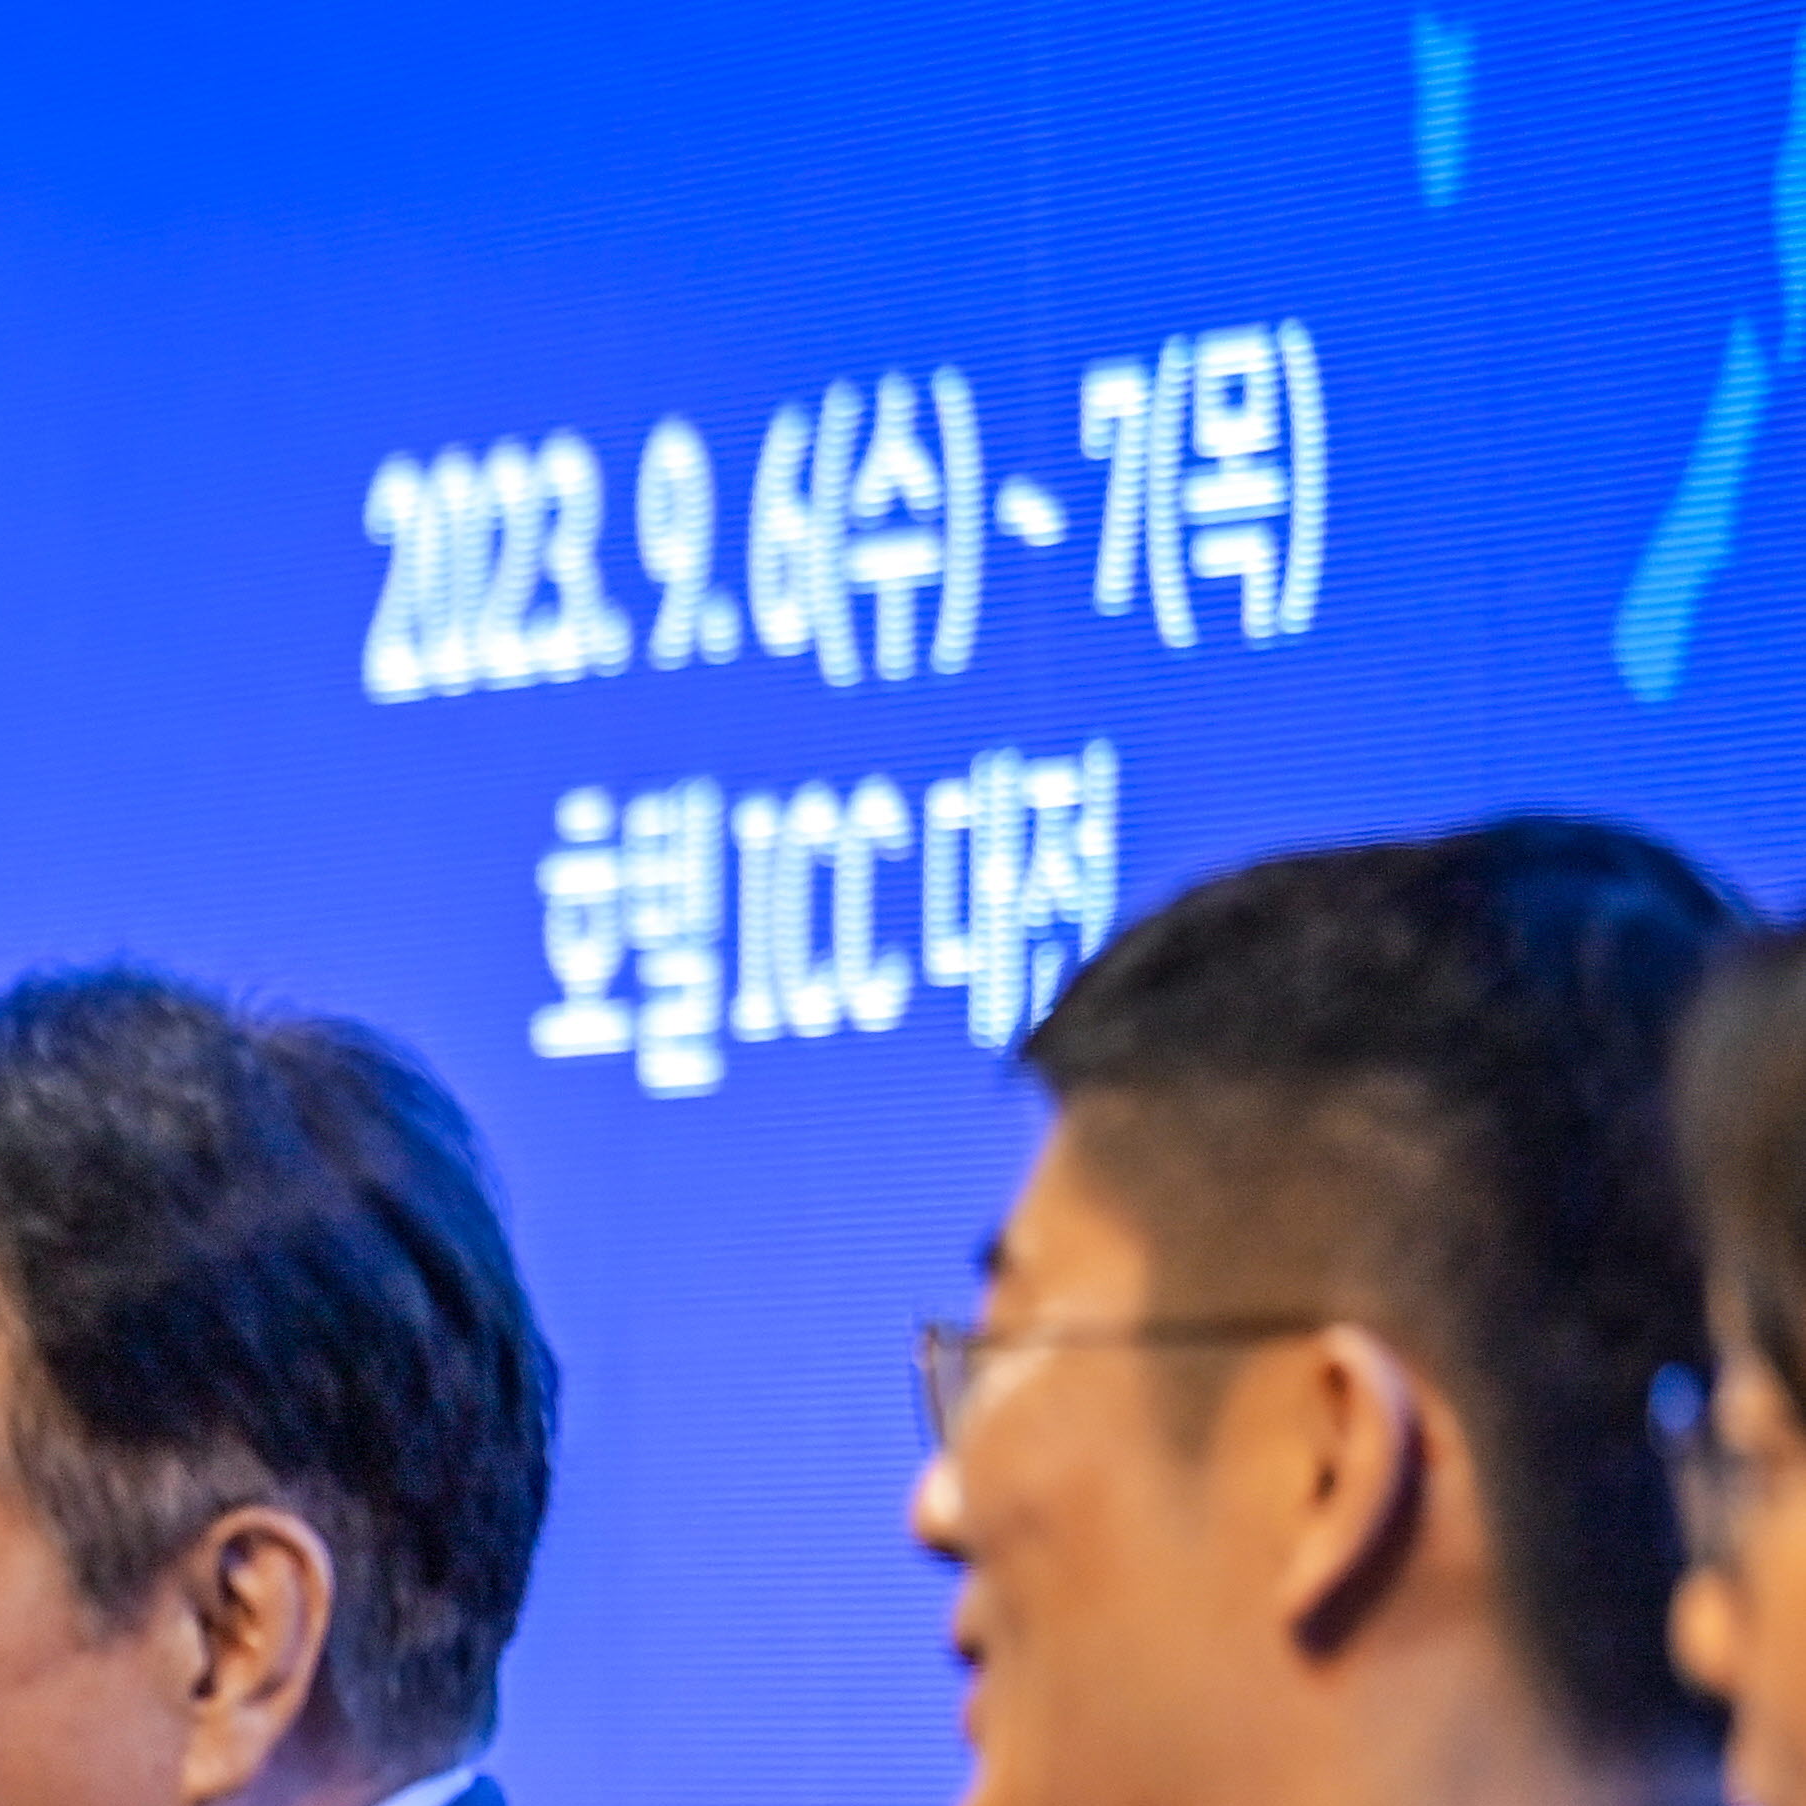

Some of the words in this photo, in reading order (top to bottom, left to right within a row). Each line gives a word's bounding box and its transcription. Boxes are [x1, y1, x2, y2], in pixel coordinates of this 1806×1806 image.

[363, 428, 631, 704] 2023.
[748, 364, 983, 688] 6(수)
[1080, 315, 1327, 648] 7(목)
[529, 774, 726, 1100] 호텔
[731, 774, 912, 1042] ICC
